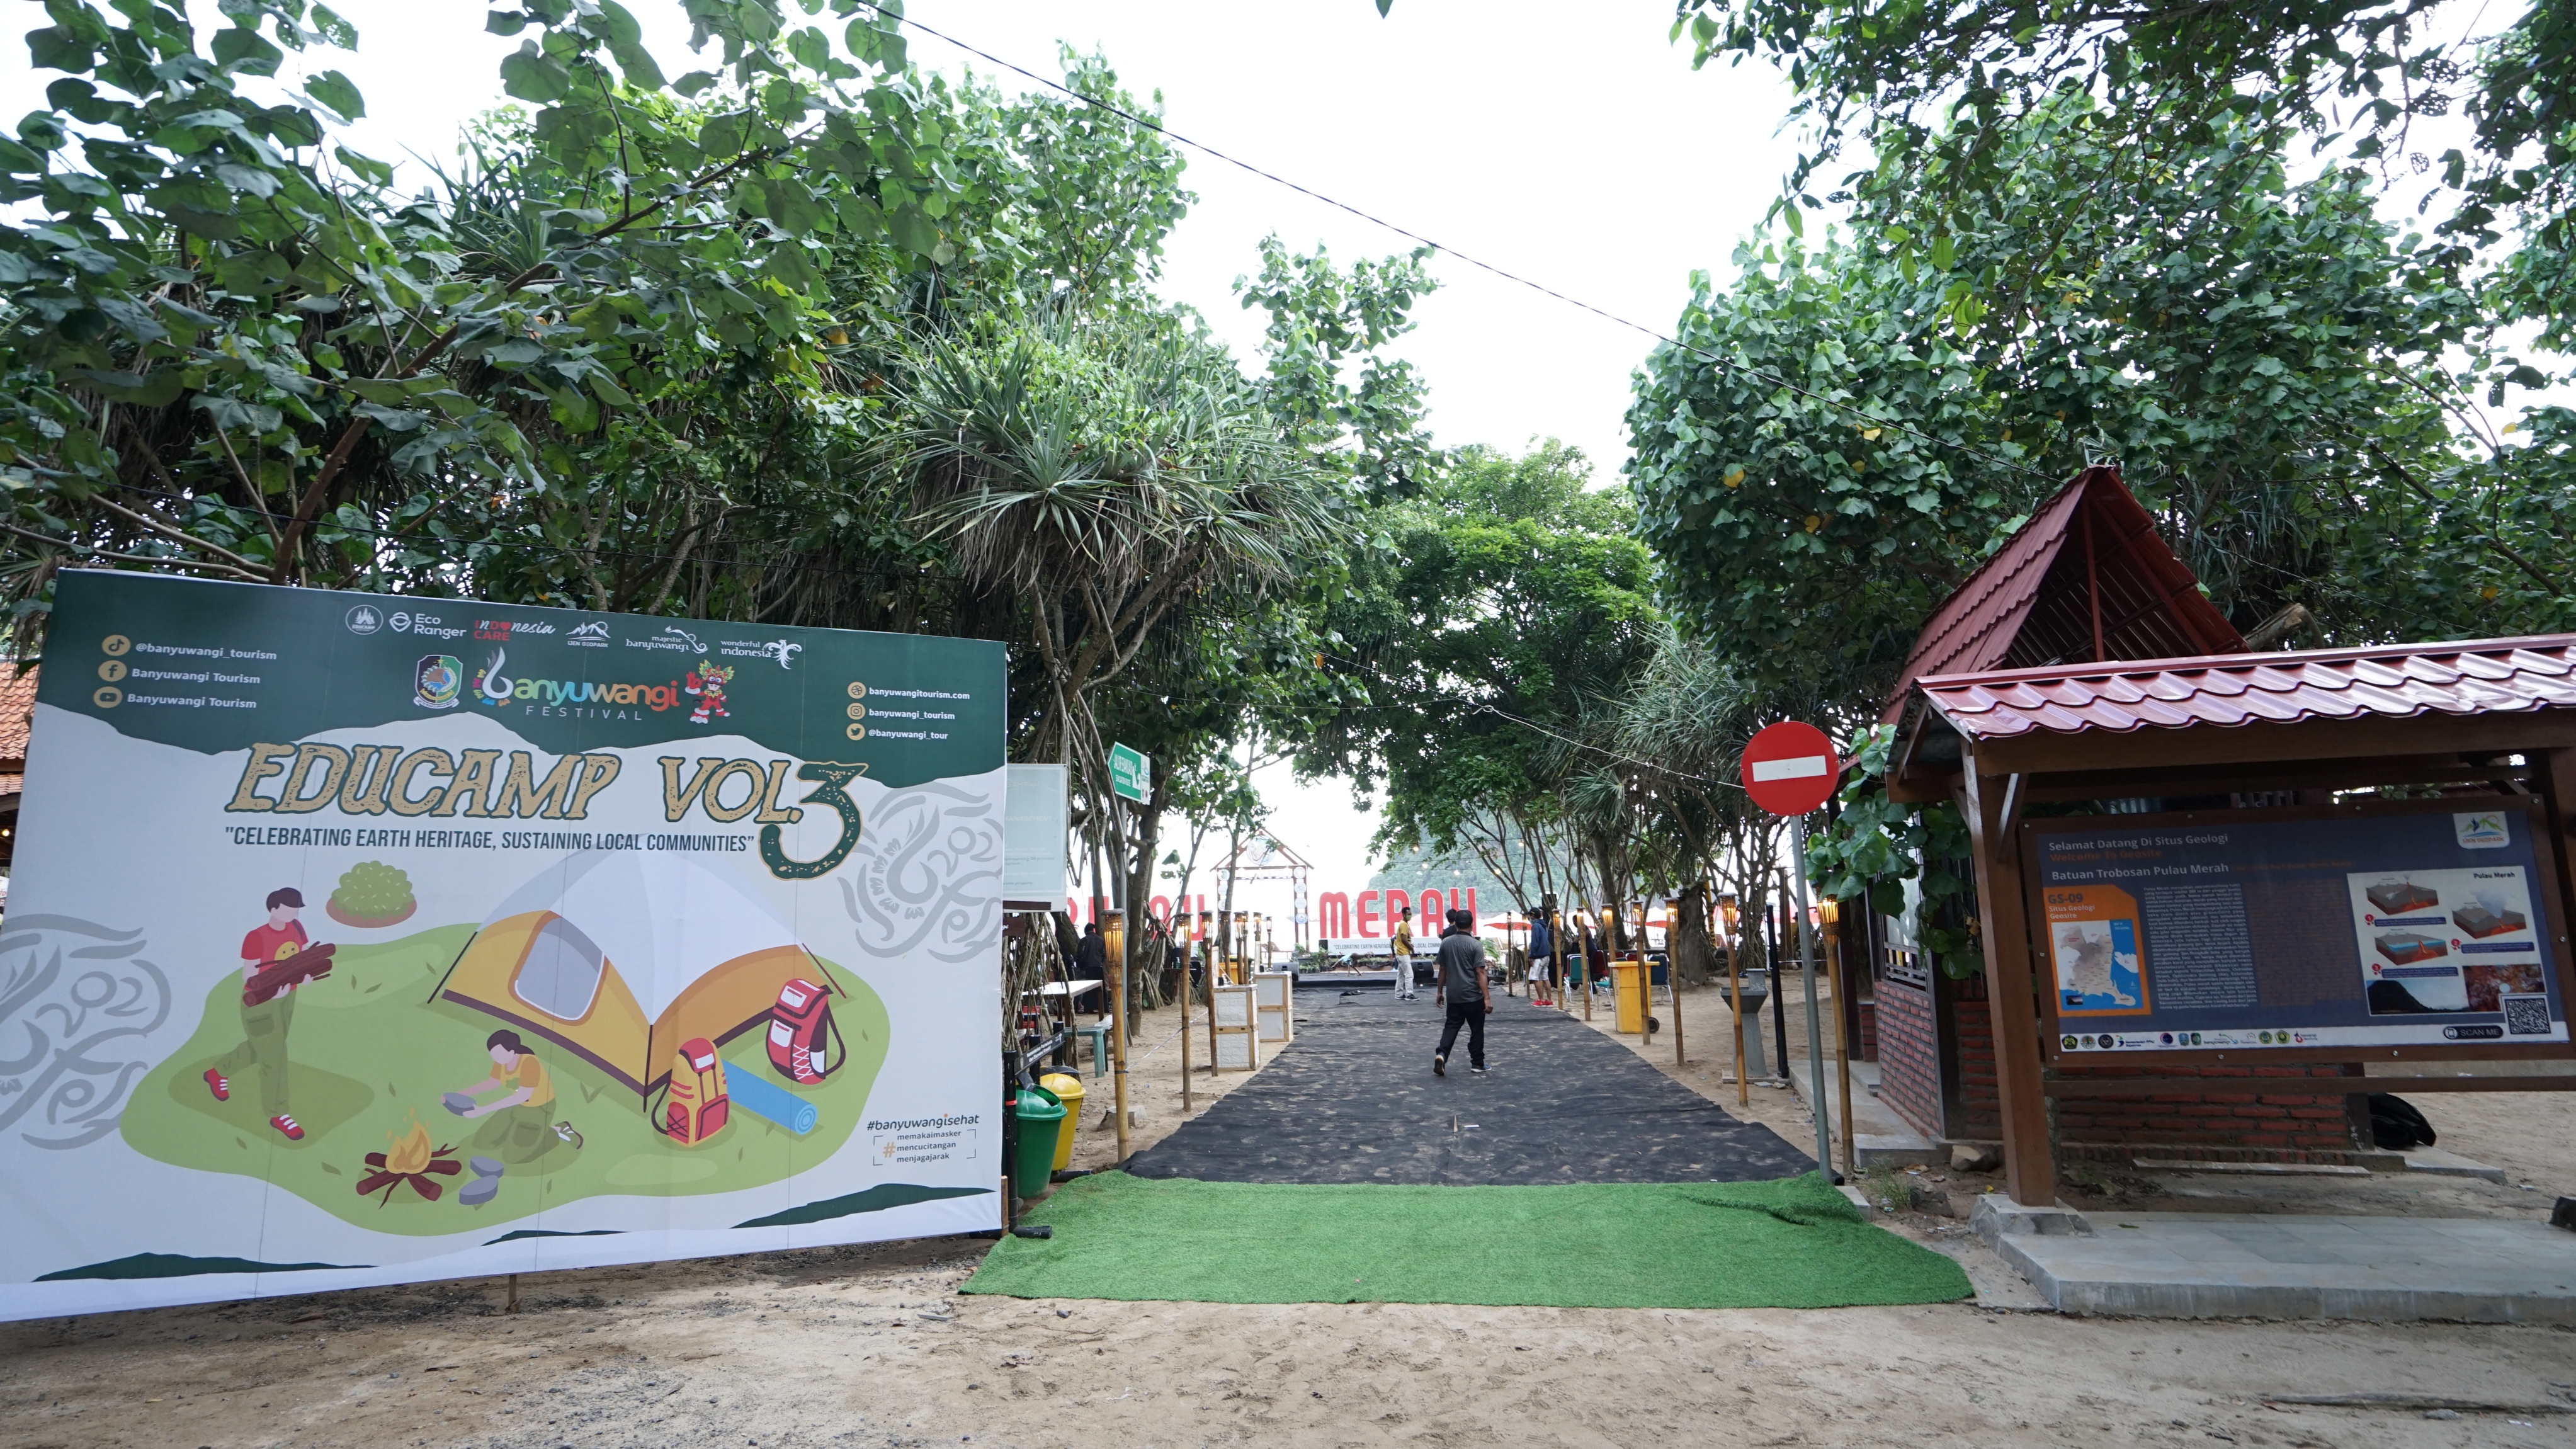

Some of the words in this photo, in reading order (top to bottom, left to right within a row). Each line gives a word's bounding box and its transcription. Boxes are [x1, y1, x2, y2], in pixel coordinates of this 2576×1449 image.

[416, 613, 441, 624] Eco
[414, 624, 467, 639] Ranger
[474, 630, 510, 641] CARE
[625, 639, 689, 652] banyuwangi
[720, 640, 761, 648] wonderful
[135, 643, 277, 660] @banyuwangi_tourism
[720, 647, 773, 657] indonesia
[132, 669, 209, 683] Banyuwangi
[213, 673, 261, 683] Tourism
[869, 687, 970, 700] banyuwangitourism.com
[127, 693, 205, 707] Banyuwangi
[209, 698, 257, 708] Tourism
[526, 705, 642, 720] FESTIVAL
[868, 708, 955, 720] banyuwangi_tourism
[868, 729, 948, 740] @banyuwangi_tour
[224, 742, 622, 819] EDUCAMP
[356, 829, 411, 848] EARTH
[415, 830, 496, 851] HERITAGE,
[501, 831, 592, 850] SUSTAINING
[596, 833, 642, 851] LOCAL
[2049, 841, 2094, 851] Selamat
[2097, 838, 2138, 850] Datang
[2140, 837, 2152, 846] Di
[2155, 836, 2183, 846] Situs
[2186, 833, 2228, 844] Geologi
[2050, 852, 2101, 862] Welcome
[2104, 851, 2117, 860] To
[2119, 849, 2162, 858] Geosite
[2051, 870, 2094, 880] Batuan
[2096, 868, 2151, 879] Trobosan
[2153, 865, 2187, 875] Pulau
[2190, 863, 2229, 873] Merah
[2048, 893, 2084, 904] GS-09
[1319, 887, 1477, 938] MERAH
[2068, 904, 2096, 912] Geologi
[2460, 1028, 2485, 1037] SCAN
[2486, 1028, 2499, 1036] ME
[867, 1113, 980, 1132] #banyuwangisehat
[897, 1130, 962, 1140] memakaimasker
[897, 1141, 956, 1152] mencucitangan
[897, 1152, 950, 1163] menjagajarak
